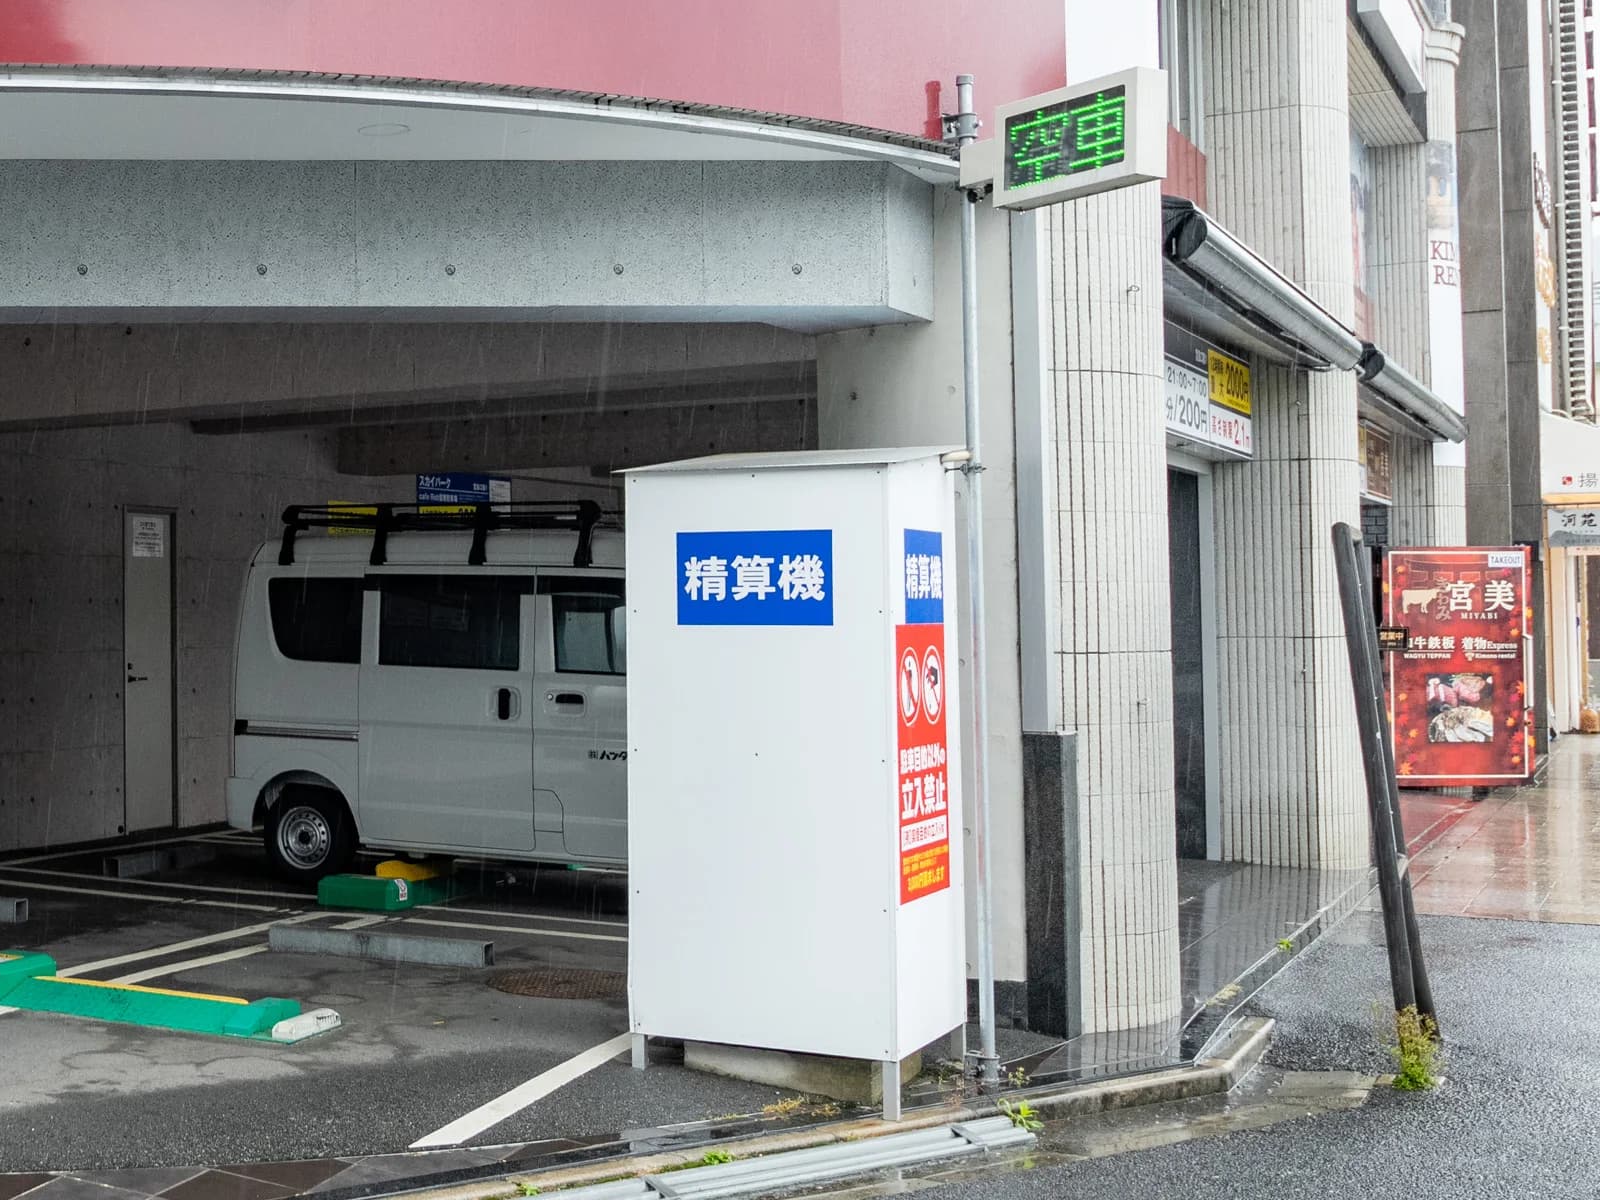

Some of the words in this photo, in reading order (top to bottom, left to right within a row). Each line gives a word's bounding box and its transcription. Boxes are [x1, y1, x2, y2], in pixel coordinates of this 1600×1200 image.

[1009, 93, 1127, 191] 空車
[684, 554, 826, 601] 精算機
[905, 553, 944, 600] 精算機
[1490, 555, 1521, 565] TAKEOUT
[1450, 579, 1515, 612] 宮美
[1460, 612, 1498, 620] MIYABI
[901, 771, 947, 820] 立入禁止
